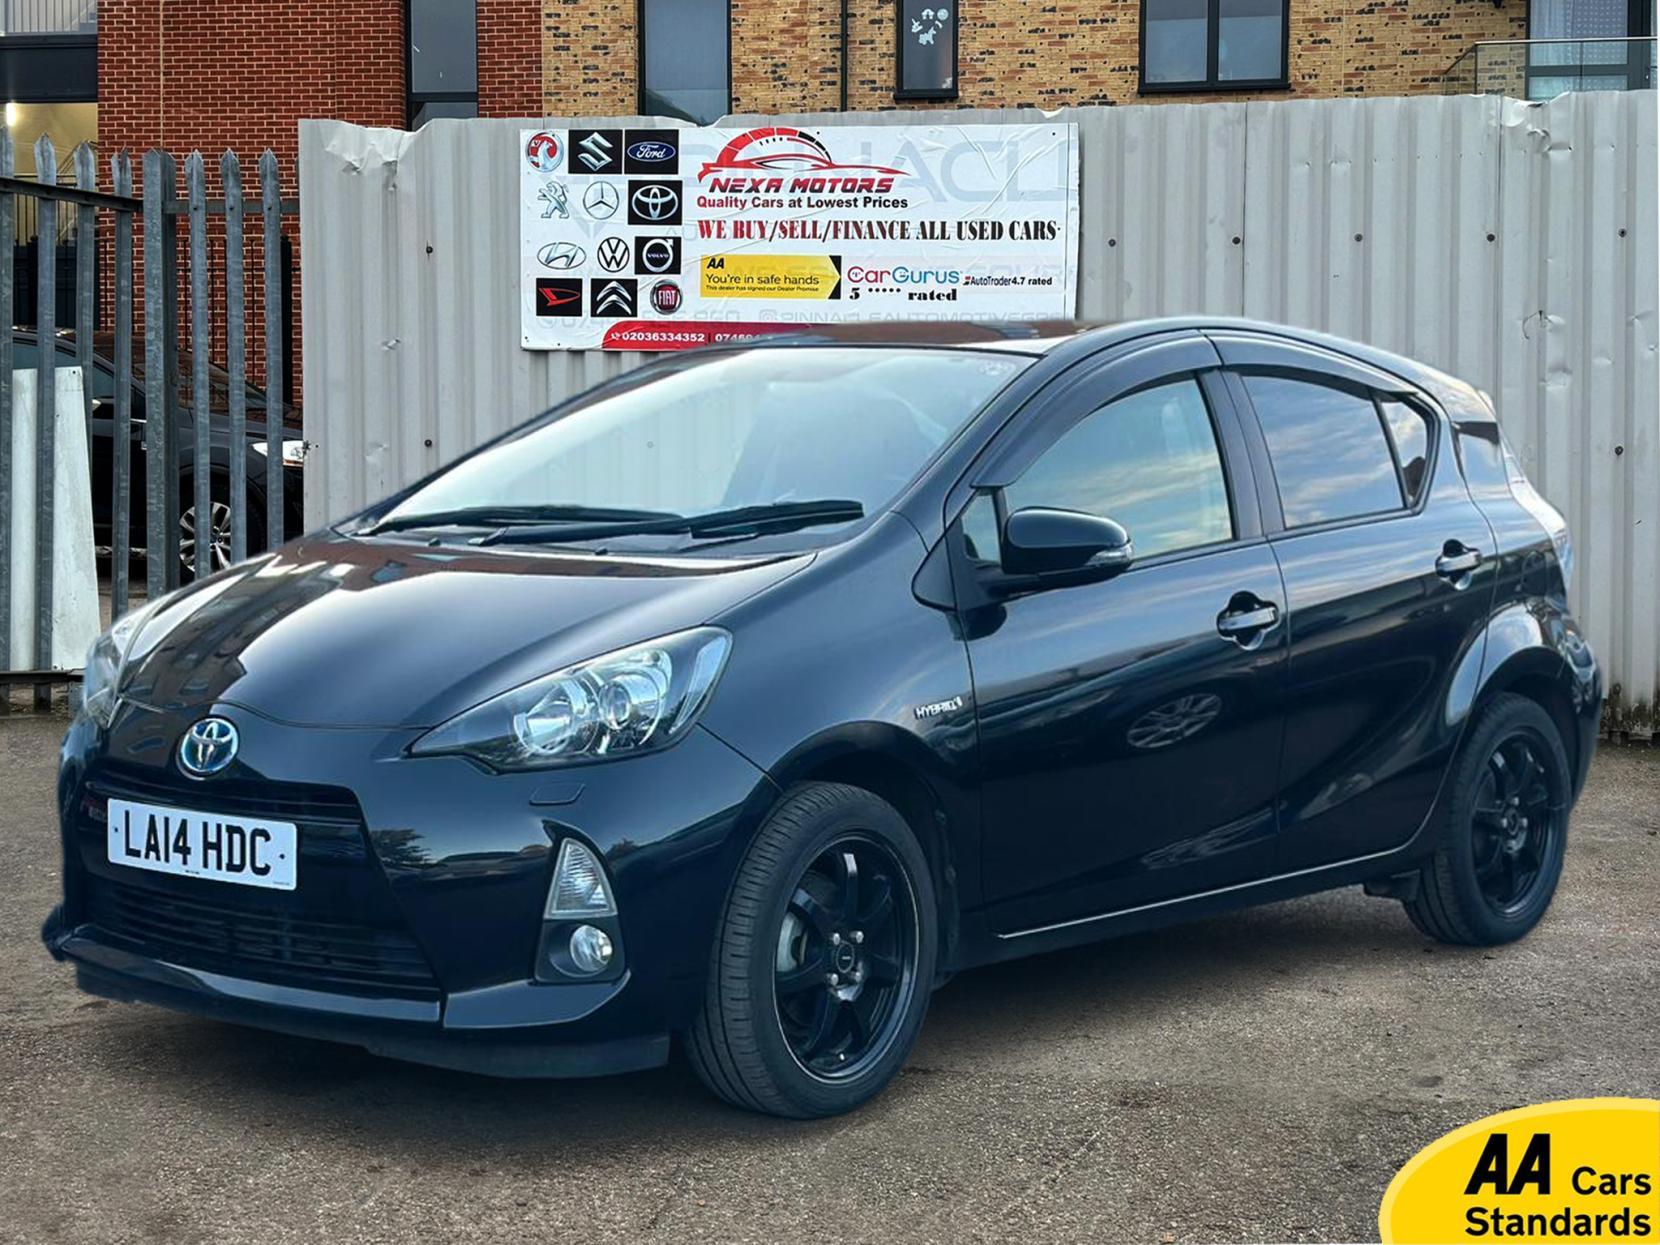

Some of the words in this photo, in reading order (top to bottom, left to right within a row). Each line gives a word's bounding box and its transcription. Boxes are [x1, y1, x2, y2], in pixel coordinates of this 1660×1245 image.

[636, 142, 668, 159] Ford
[708, 177, 785, 194] NEXA
[788, 177, 895, 194] MOTORS
[696, 195, 750, 211] Quality
[751, 195, 785, 209] Cars
[788, 196, 803, 209] at
[807, 195, 861, 209] Lowest
[863, 195, 908, 209] Prices
[697, 219, 727, 240] WE
[915, 220, 951, 241] ALL
[956, 220, 1004, 241] USED
[1008, 220, 1057, 241] CARS
[646, 251, 670, 259] VOLVO
[706, 257, 725, 270] AA
[705, 273, 742, 284] You're
[743, 273, 755, 284] in
[757, 273, 781, 285] safe
[783, 273, 820, 285] hands
[847, 265, 960, 285] CarGurus
[1027, 276, 1053, 286] rated
[658, 289, 678, 306] FIAT
[849, 287, 861, 301] 5
[907, 288, 958, 301] rated
[621, 331, 705, 342] 02036334352
[914, 699, 958, 719] HYBRID
[124, 809, 192, 866] LA14
[202, 821, 272, 876] HDC
